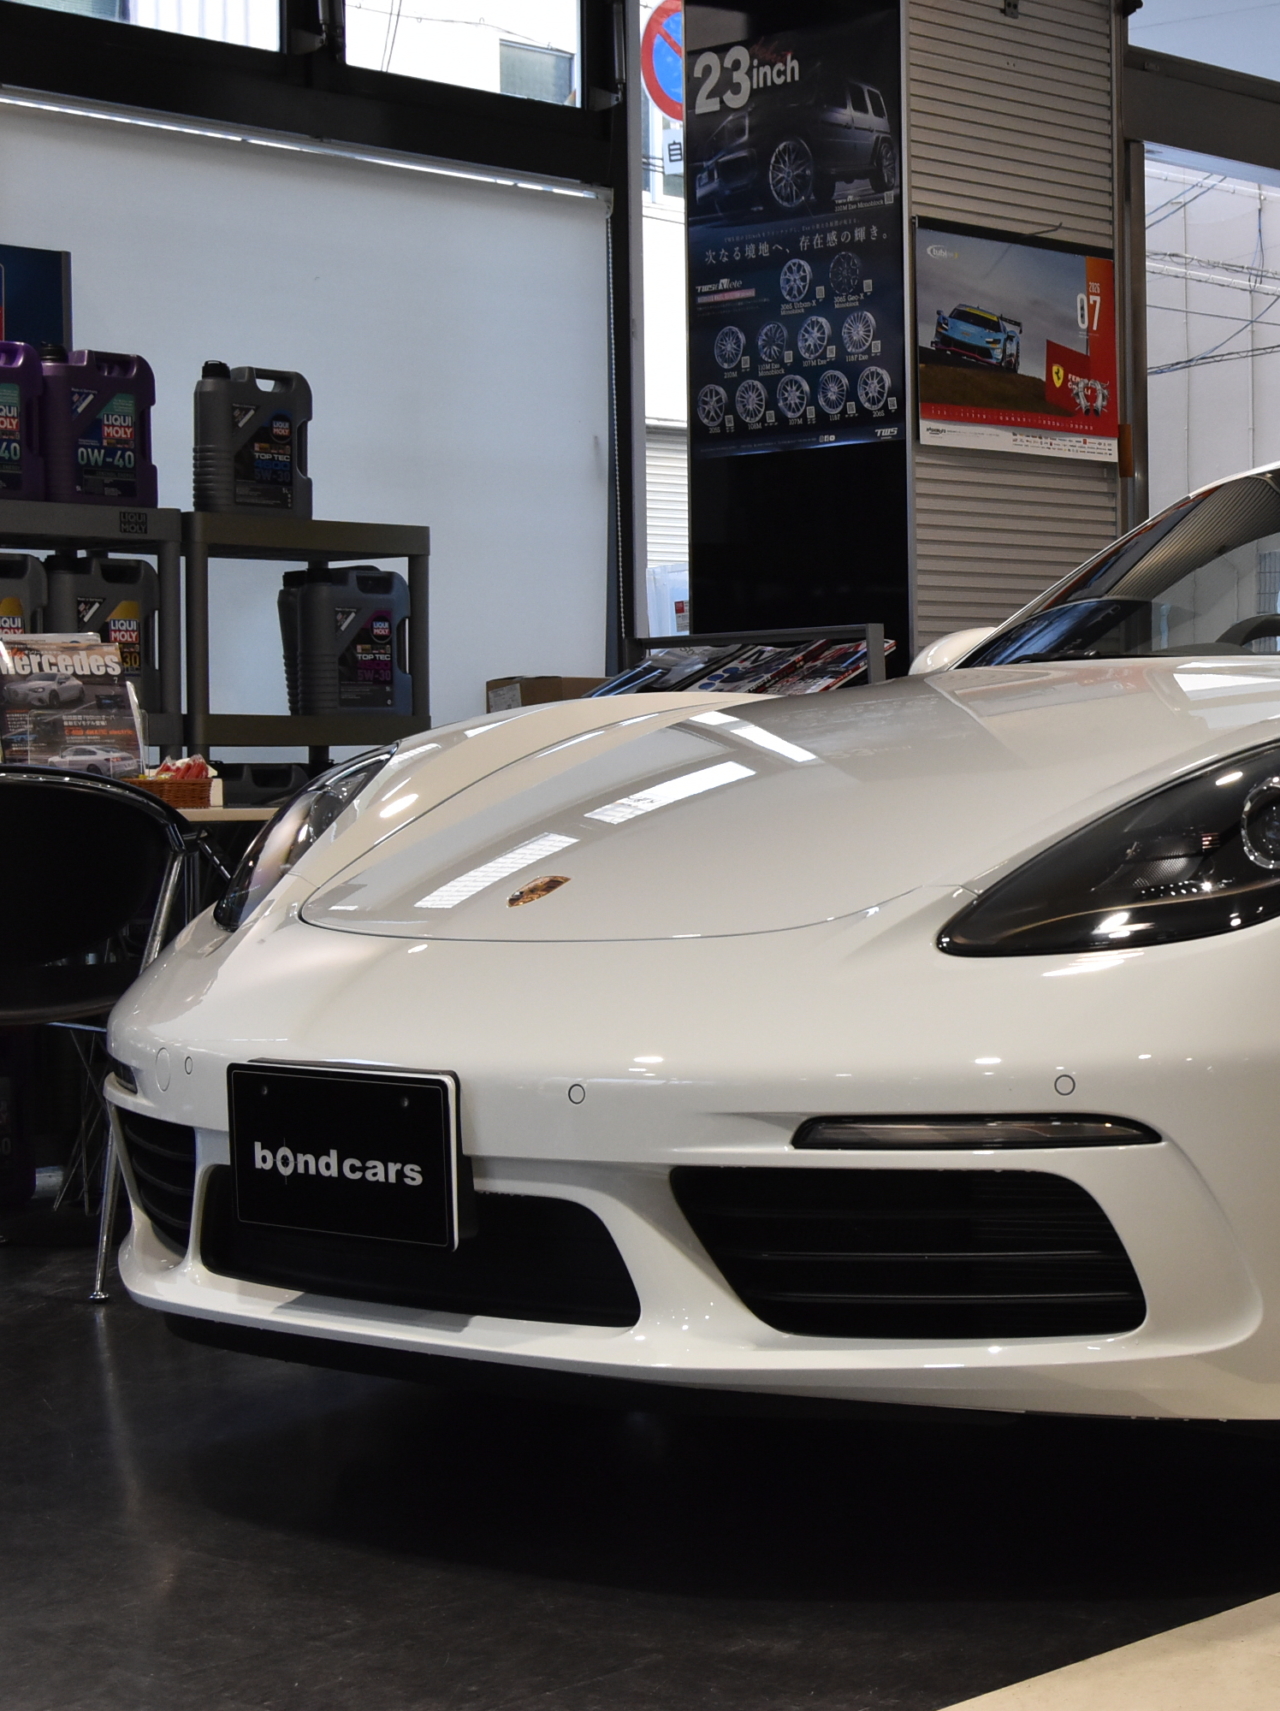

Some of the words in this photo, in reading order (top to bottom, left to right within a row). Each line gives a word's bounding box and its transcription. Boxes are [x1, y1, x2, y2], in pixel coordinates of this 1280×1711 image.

[694, 46, 750, 114] 23
[752, 54, 800, 89] inch
[704, 241, 790, 265] 次なる境地へ、
[800, 225, 888, 251] 存在感の輝き。
[1076, 293, 1101, 331] 07
[104, 414, 132, 426] LIQUI
[104, 426, 134, 438] MOLY
[78, 447, 135, 468] 0W-40
[254, 452, 272, 460] TOP
[273, 454, 290, 462] TEC
[120, 512, 146, 522] LIQUI
[122, 522, 147, 533] MOLY
[110, 620, 137, 630] LIQUI
[111, 631, 138, 642] MOLY
[357, 670, 392, 681] 5W-30
[254, 1141, 338, 1178] bond
[342, 1158, 424, 1186] cars
